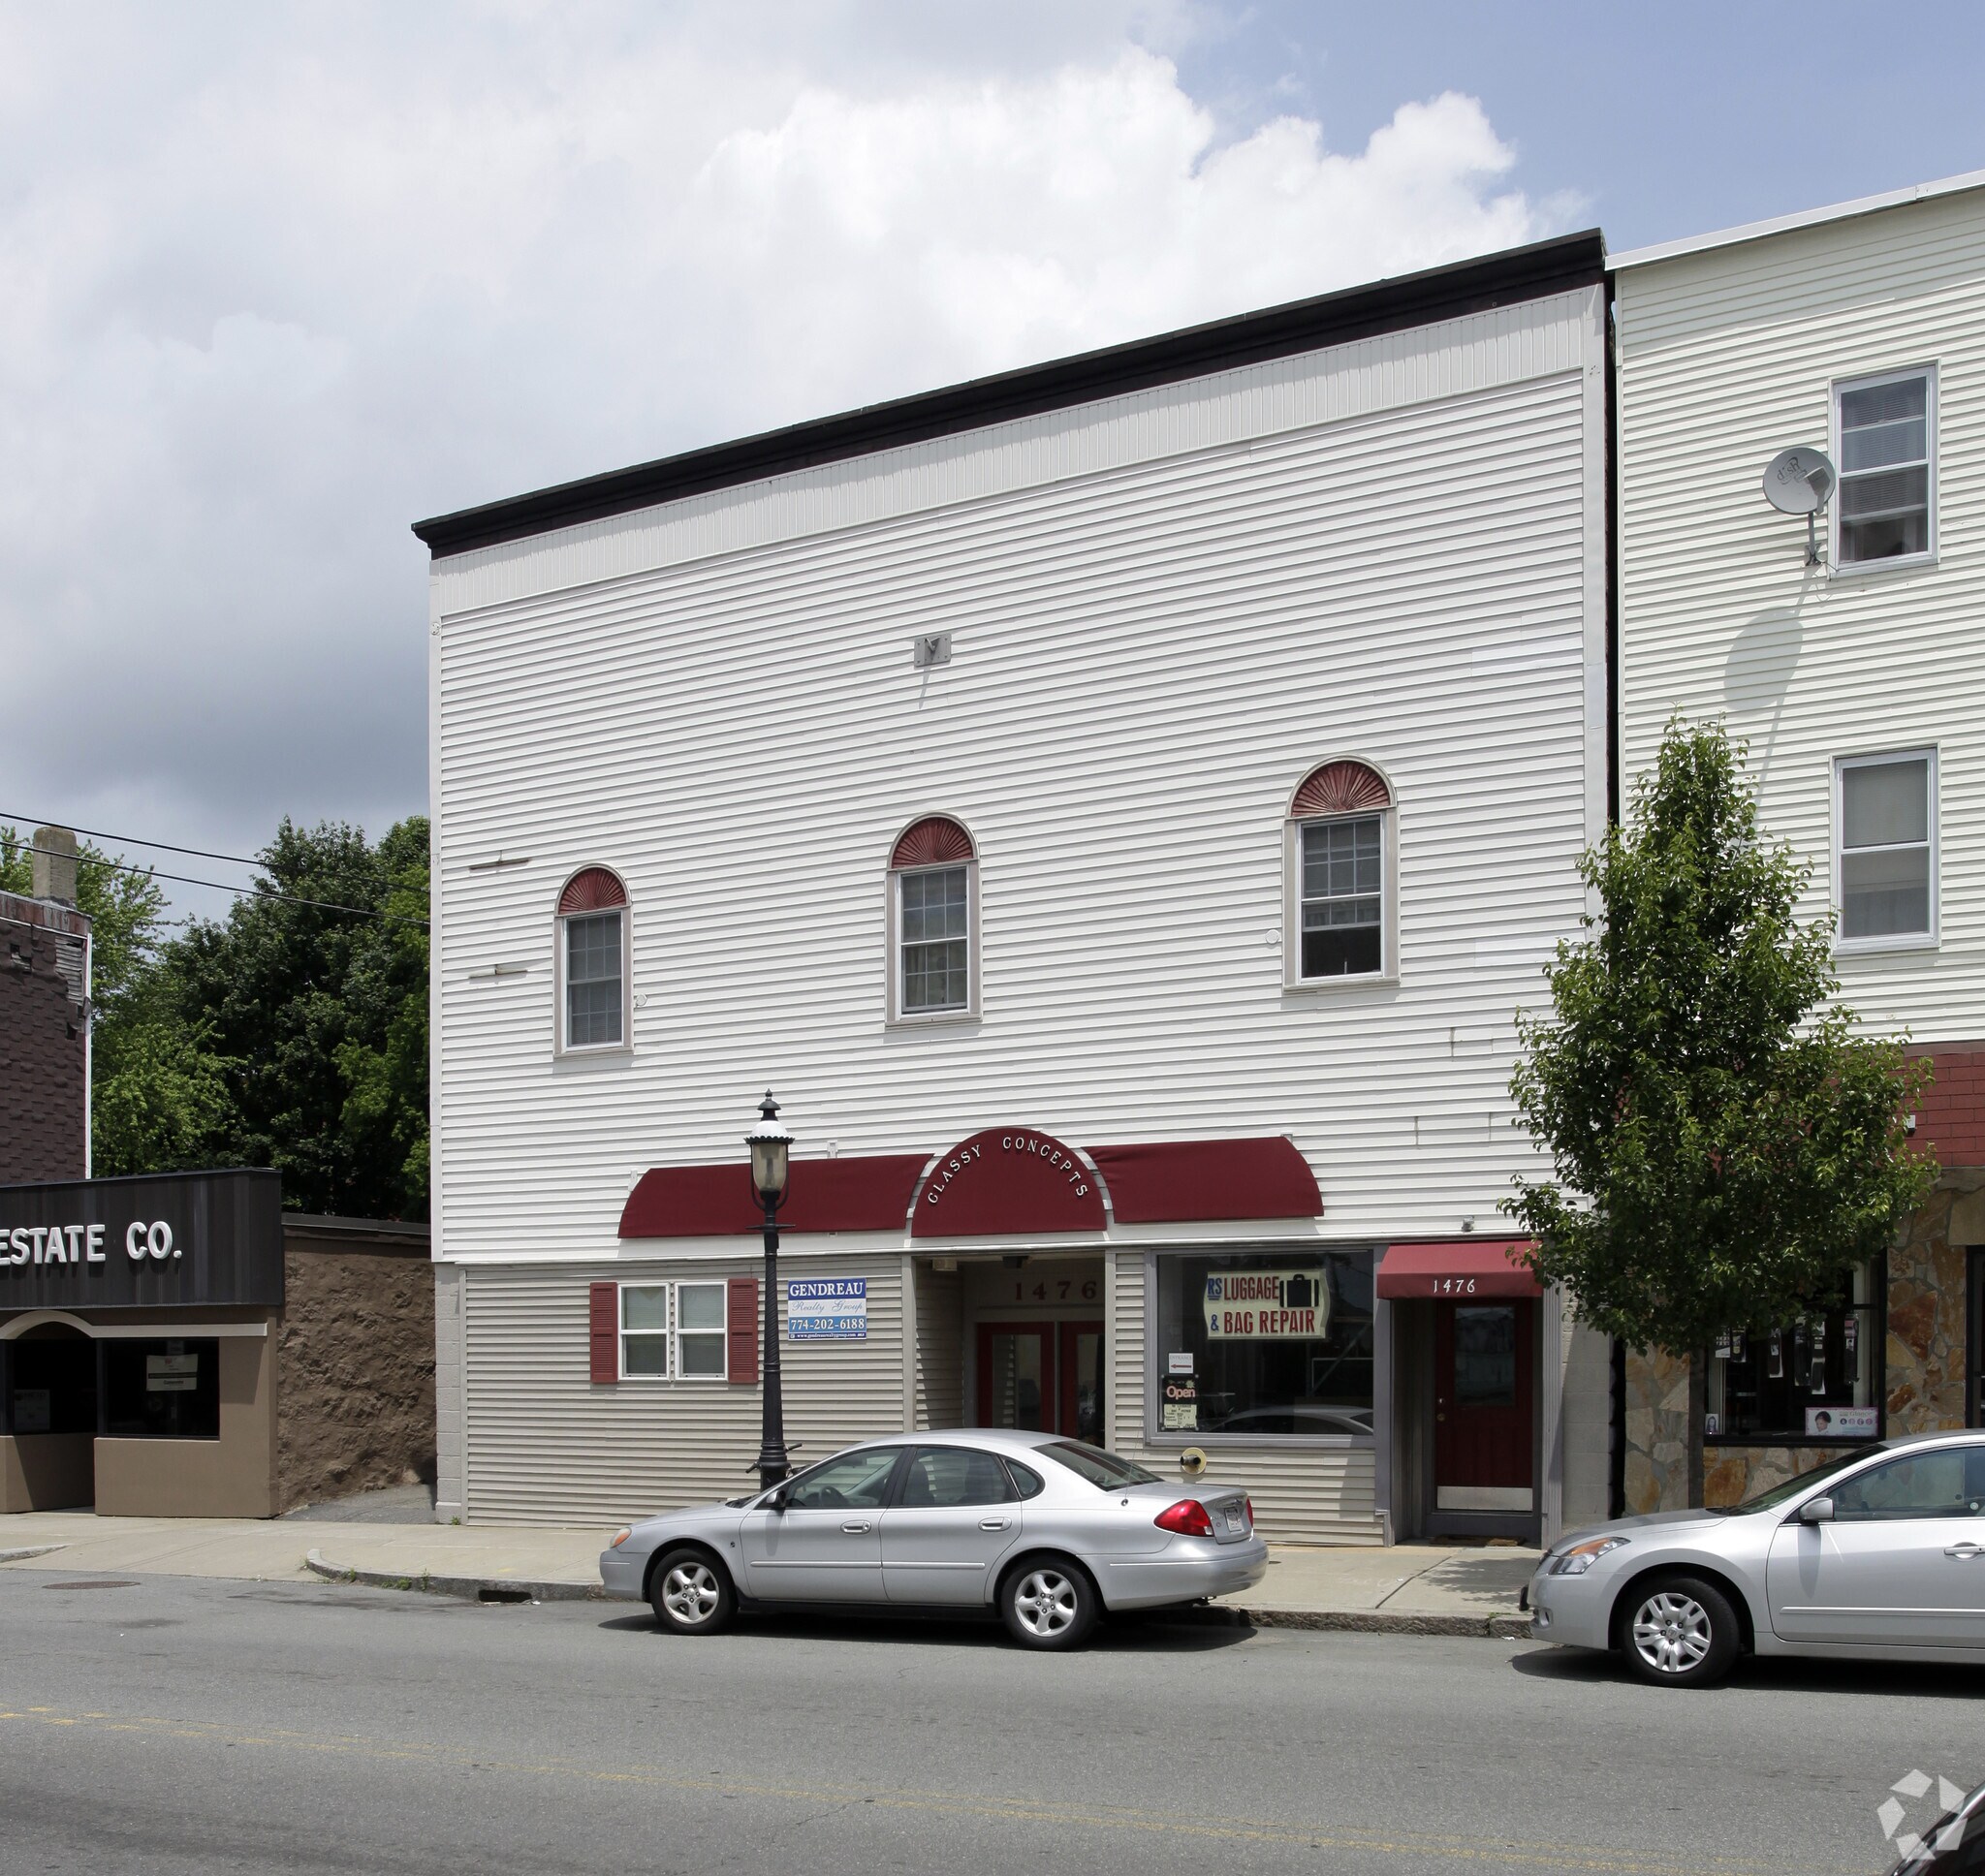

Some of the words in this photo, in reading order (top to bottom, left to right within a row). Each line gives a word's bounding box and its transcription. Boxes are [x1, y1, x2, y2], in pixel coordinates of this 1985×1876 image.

[928, 1144, 981, 1204] CLASSY
[1002, 1137, 1088, 1197] CONCEPTS
[0, 1224, 106, 1266] ESTATE
[126, 1221, 182, 1260] CO.
[789, 1282, 864, 1297] GENDREAU
[1015, 1280, 1097, 1300] 1476
[1207, 1277, 1222, 1296] RS
[1224, 1276, 1279, 1300] LUGGAGE
[1434, 1278, 1475, 1294] 1476
[792, 1300, 825, 1314] Realty
[832, 1298, 863, 1313] Group
[790, 1318, 865, 1330] 774-202-6188
[1210, 1313, 1219, 1331] &
[1223, 1311, 1254, 1334] BAG
[1259, 1309, 1315, 1333] REPAIR
[1166, 1385, 1196, 1400] Open
